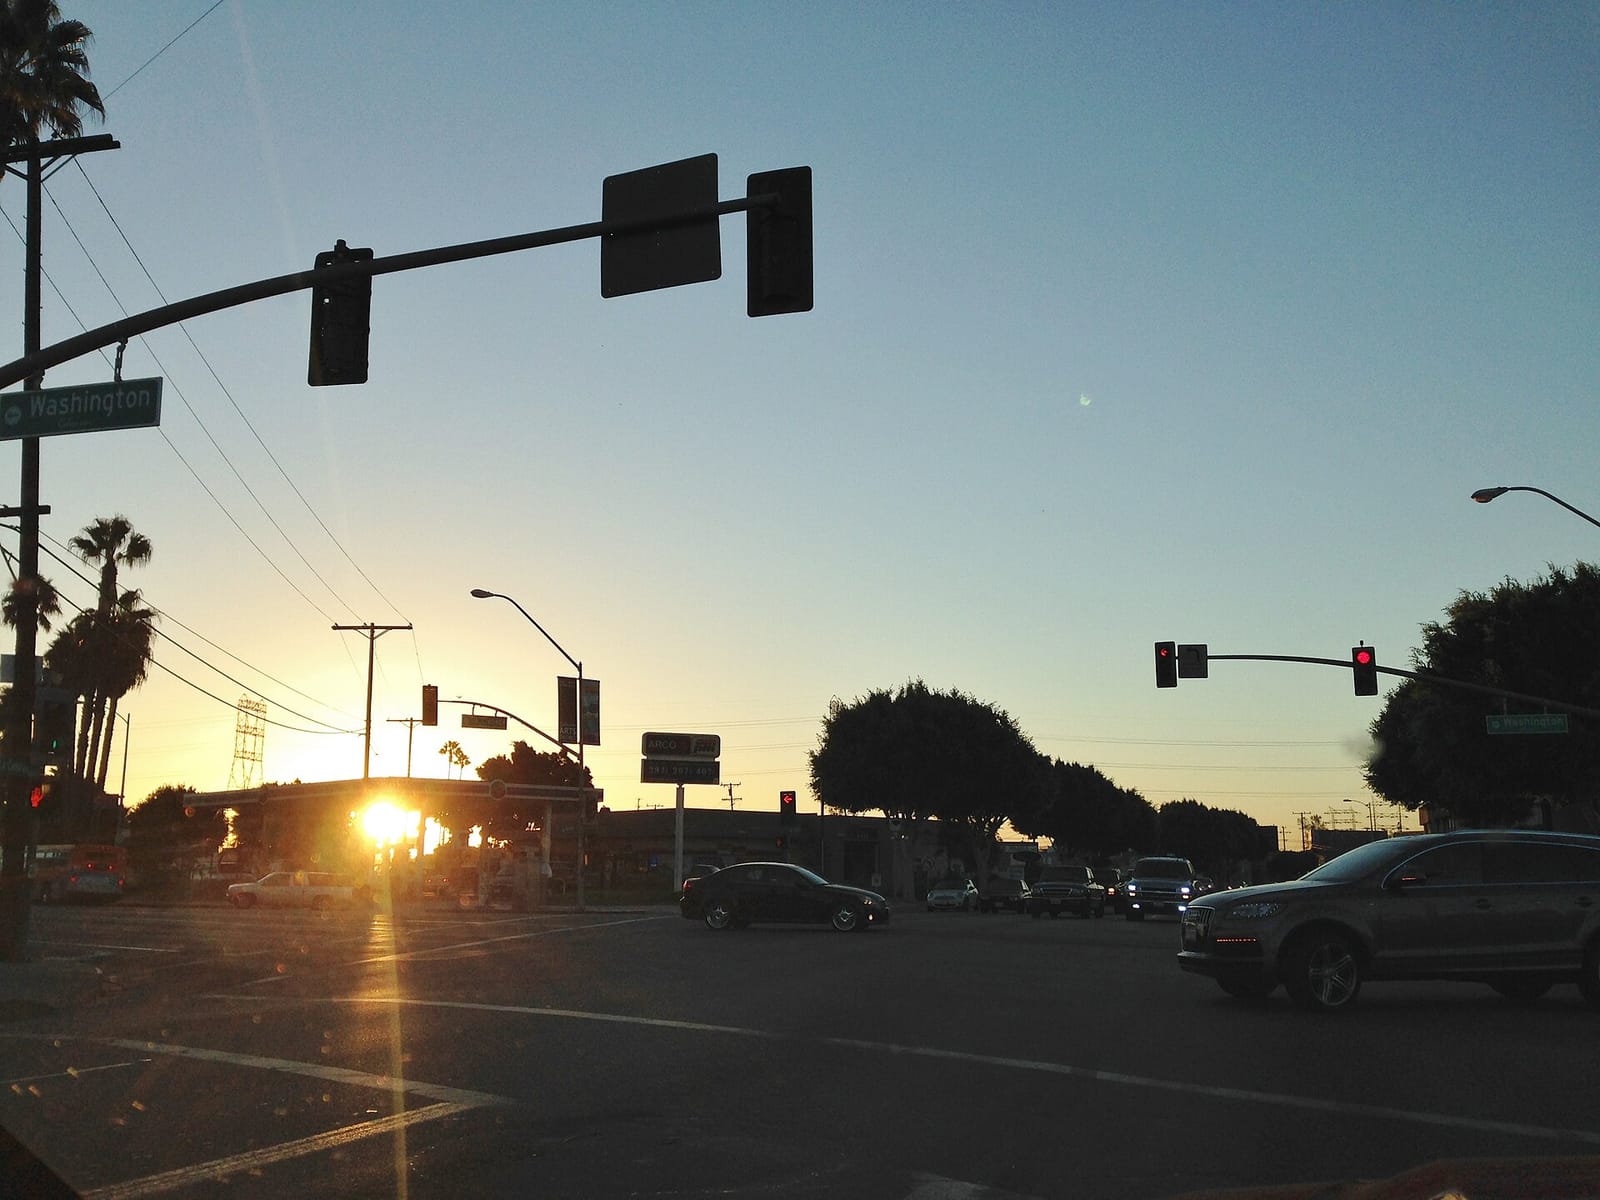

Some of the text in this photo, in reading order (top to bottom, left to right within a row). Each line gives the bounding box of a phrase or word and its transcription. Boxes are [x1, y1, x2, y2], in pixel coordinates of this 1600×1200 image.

[30, 387, 150, 417] Washington
[1503, 717, 1565, 729] Washington
[647, 740, 677, 750] ARCO
